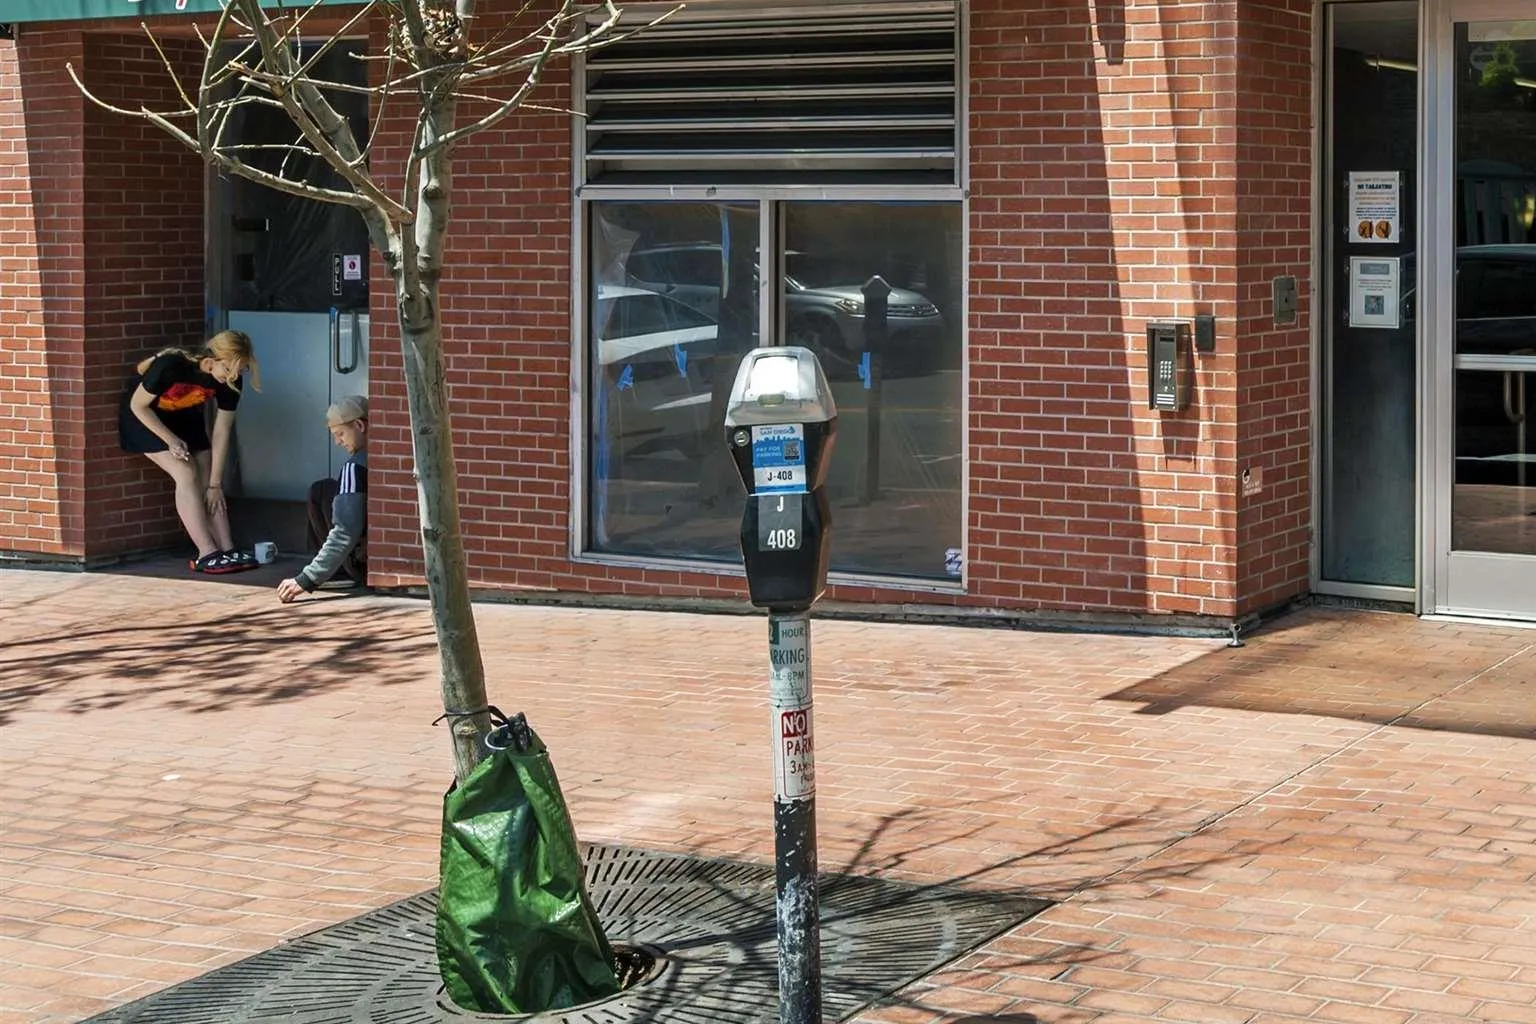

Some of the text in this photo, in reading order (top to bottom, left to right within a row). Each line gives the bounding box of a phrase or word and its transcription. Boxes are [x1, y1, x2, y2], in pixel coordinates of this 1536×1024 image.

[768, 470, 793, 482] J-408
[776, 496, 785, 512] J
[767, 529, 796, 549] 408
[781, 627, 805, 639] HOUR
[783, 713, 806, 735] NO
